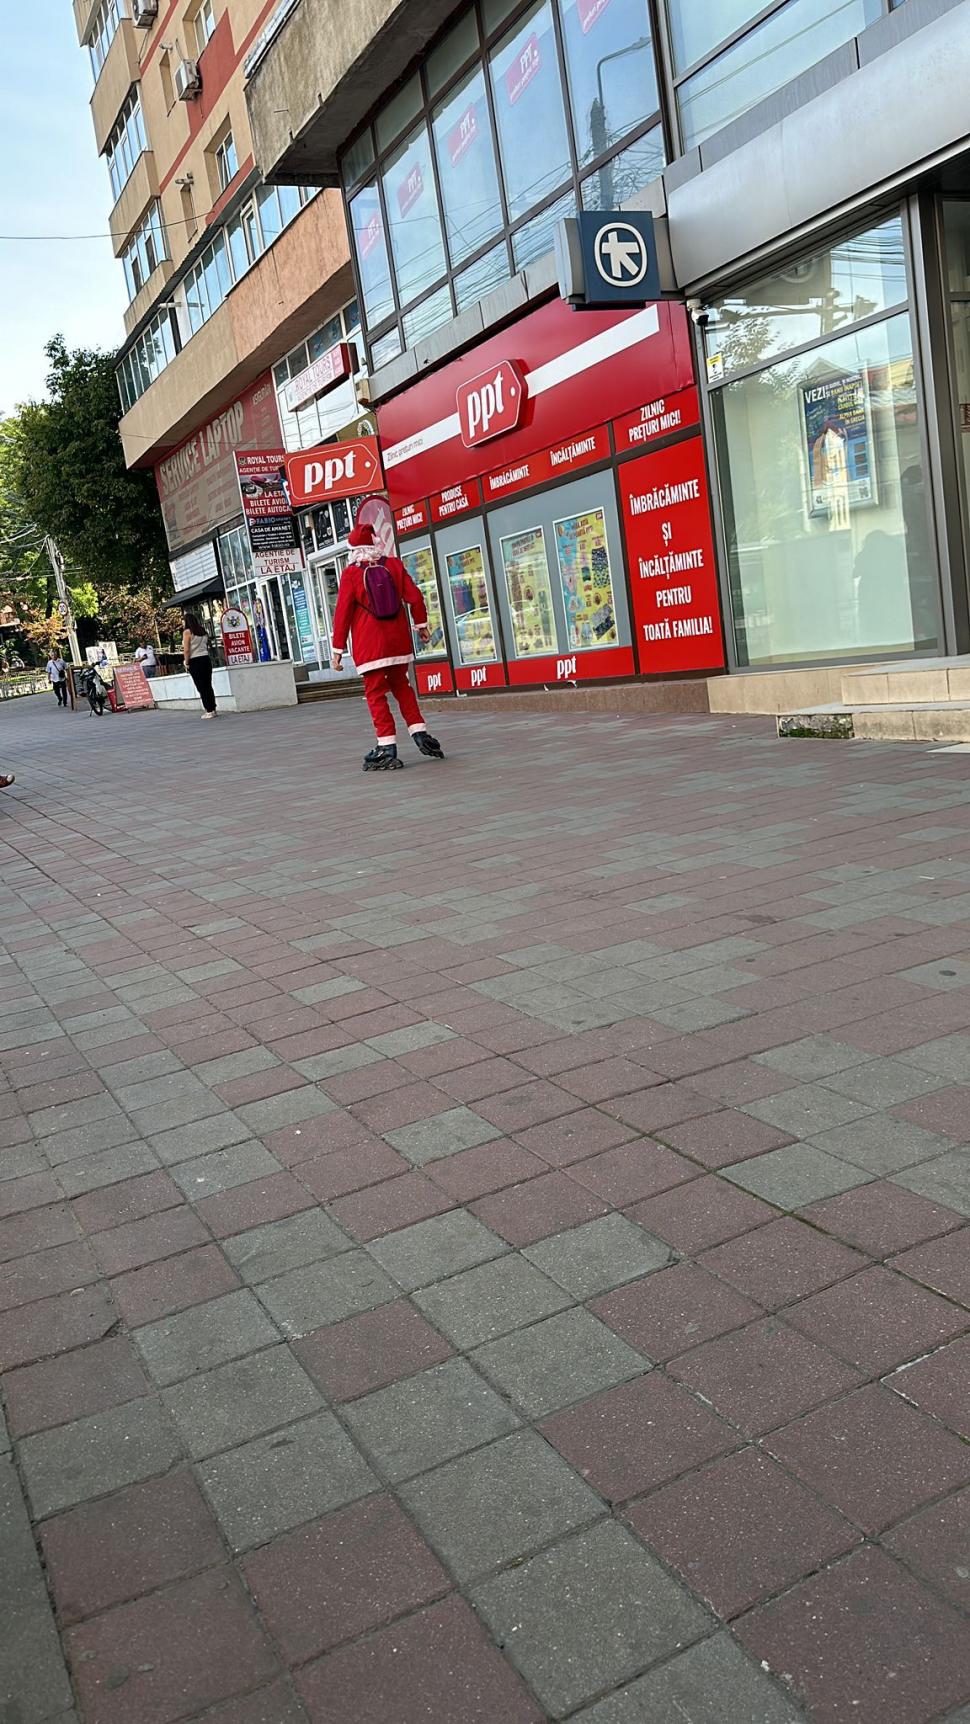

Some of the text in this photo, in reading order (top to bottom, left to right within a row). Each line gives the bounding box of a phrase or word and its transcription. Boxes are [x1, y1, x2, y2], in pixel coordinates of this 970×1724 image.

[312, 355, 332, 378] TOURS
[467, 370, 504, 440] ppt
[804, 386, 826, 404] VEZI
[640, 399, 664, 421] ZILNIC
[660, 409, 681, 430] MICI!
[160, 438, 199, 497] SERVICE
[199, 400, 244, 467] LAPTOP
[247, 454, 285, 465] ROYAL TOURS
[304, 450, 357, 494] ppt
[249, 497, 289, 507] BILETE AVIO
[441, 485, 463, 504] PRODUSE
[629, 479, 700, 516] ÎMBRĂCĂMINTE
[245, 507, 266, 515] BILETE
[661, 521, 672, 548] ȘI
[264, 557, 290, 566] TURISM
[285, 548, 296, 556] DE
[260, 564, 296, 575] LA ETAJ
[638, 549, 704, 581] ÎNCĂLȚĂMINTE
[656, 585, 692, 608] PENTRU
[643, 616, 714, 641] TOATĂ FAMILIA!
[471, 665, 487, 687] ppt
[556, 655, 577, 680] ppt
[427, 671, 442, 691] ppt
